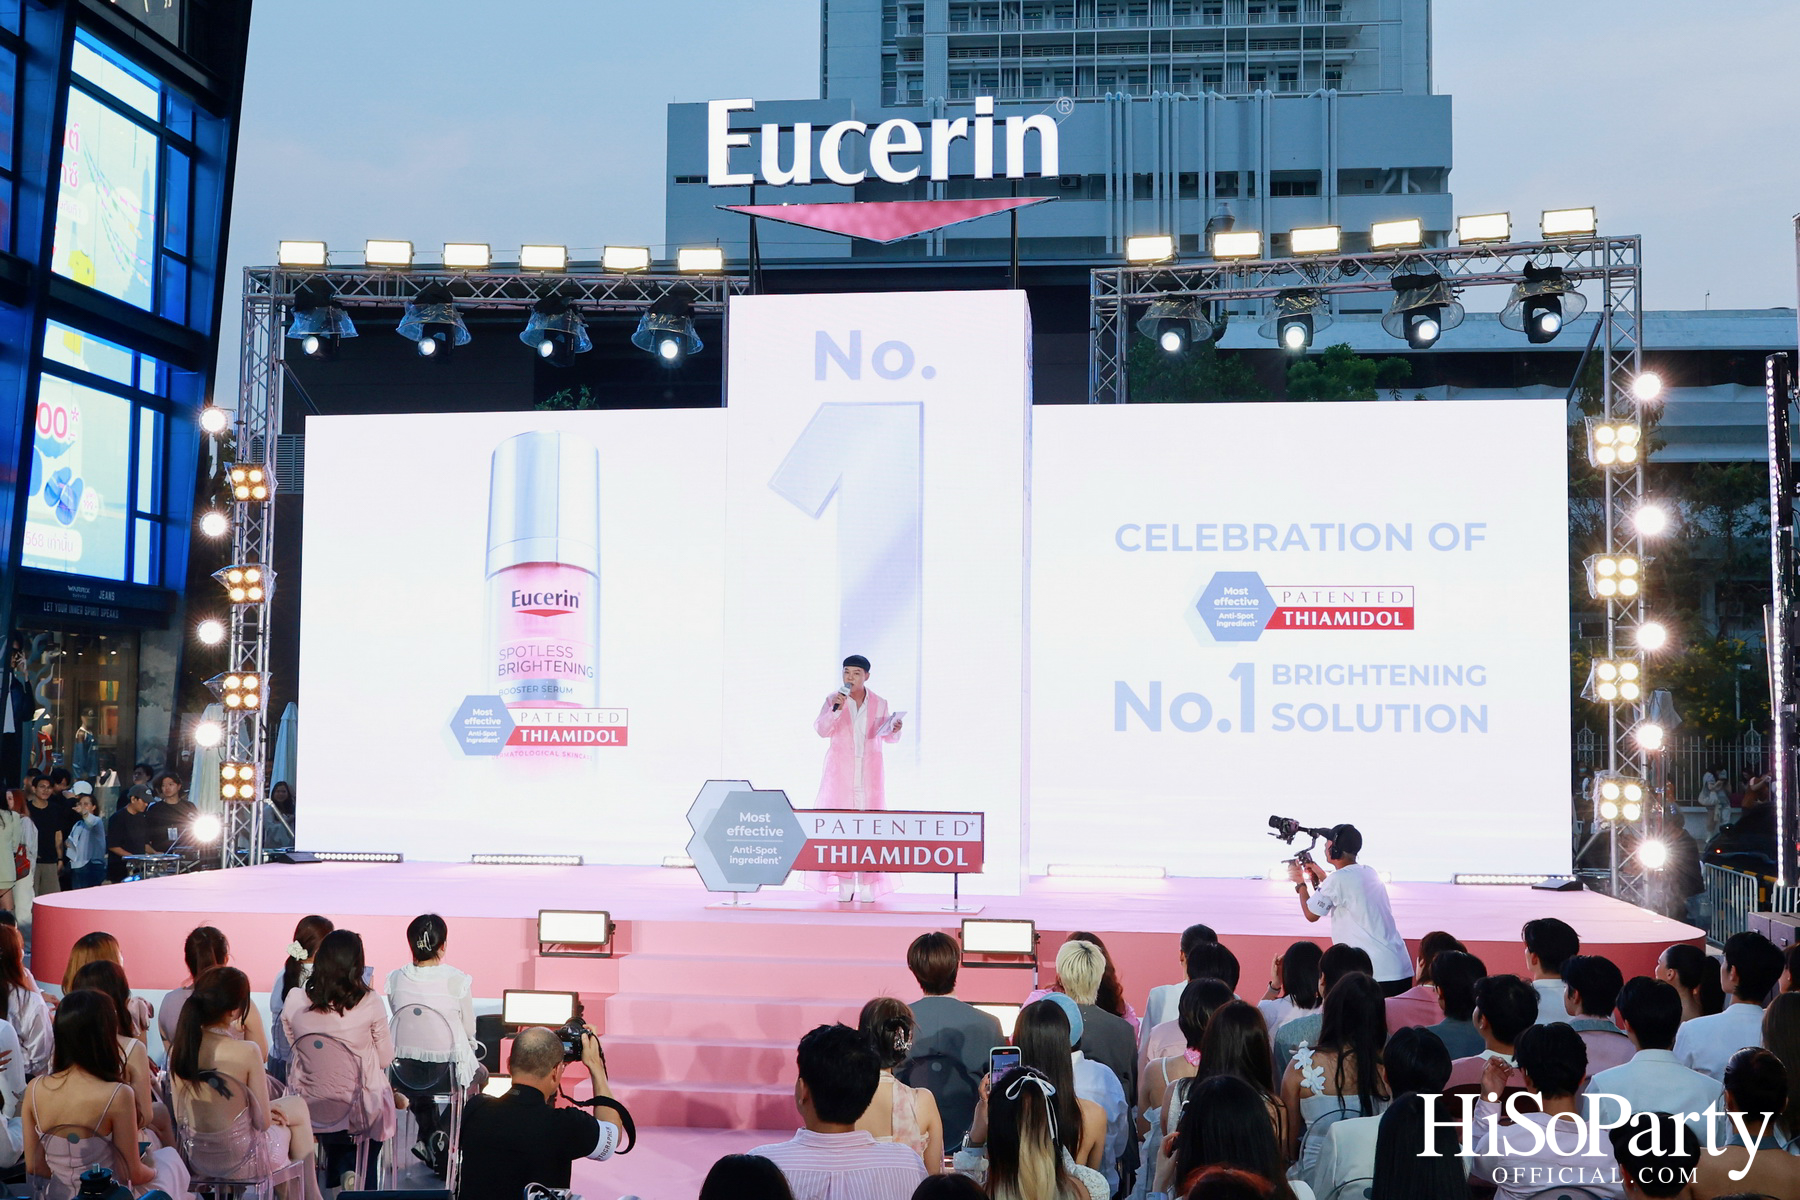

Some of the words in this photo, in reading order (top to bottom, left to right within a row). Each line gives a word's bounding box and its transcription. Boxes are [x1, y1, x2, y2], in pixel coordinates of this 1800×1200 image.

[814, 329, 936, 381] No.
[1115, 522, 1413, 552] CELEBRATION
[1428, 522, 1488, 552] OF
[1223, 587, 1249, 596] Most
[1282, 591, 1404, 603] PATENTED
[1213, 597, 1260, 606] effective
[1218, 612, 1255, 620] Anti-Spot
[1282, 611, 1404, 626] THIAMIDOL
[499, 645, 574, 661] SPOTLESS
[498, 660, 594, 679] BRIGHTENING
[499, 685, 539, 696] BOOSTER
[541, 684, 573, 694] SERUM
[1114, 662, 1255, 733] No.1
[1272, 664, 1487, 687] BRIGHTENING
[472, 708, 493, 717] Most
[520, 712, 620, 724] PATENTED
[1272, 702, 1488, 734] SOLUTION
[464, 718, 502, 726] effective
[520, 729, 619, 743] THIAMIDOL
[739, 812, 771, 823] Most
[726, 826, 784, 837] effective
[732, 846, 778, 856] Anti-Spot
[814, 845, 968, 866] THIAMIDOL
